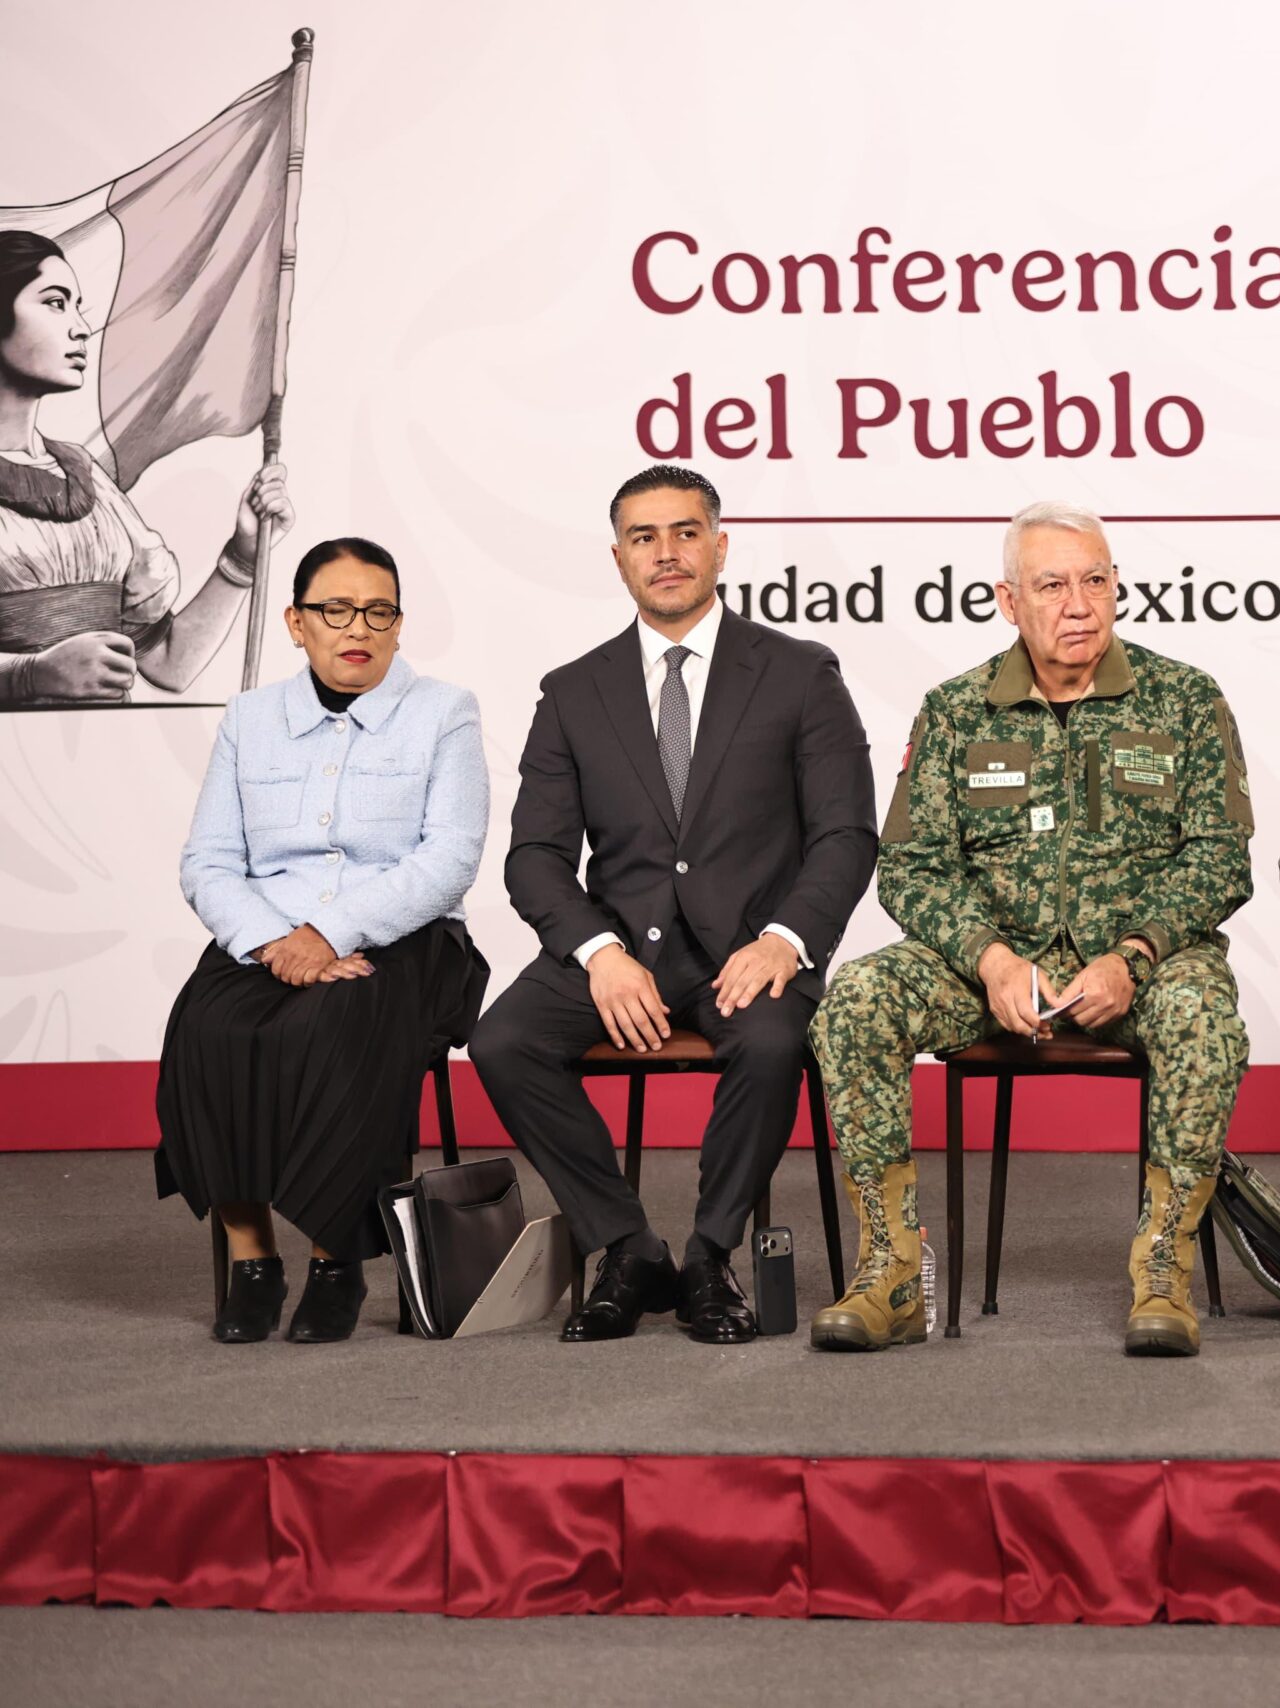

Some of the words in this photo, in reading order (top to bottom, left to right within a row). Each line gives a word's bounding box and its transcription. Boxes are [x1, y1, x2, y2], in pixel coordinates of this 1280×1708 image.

[636, 372, 793, 460] del
[835, 370, 1205, 460] Pueblo
[716, 564, 884, 624] udad
[914, 564, 997, 623] de
[971, 775, 1023, 785] TREVILLA
